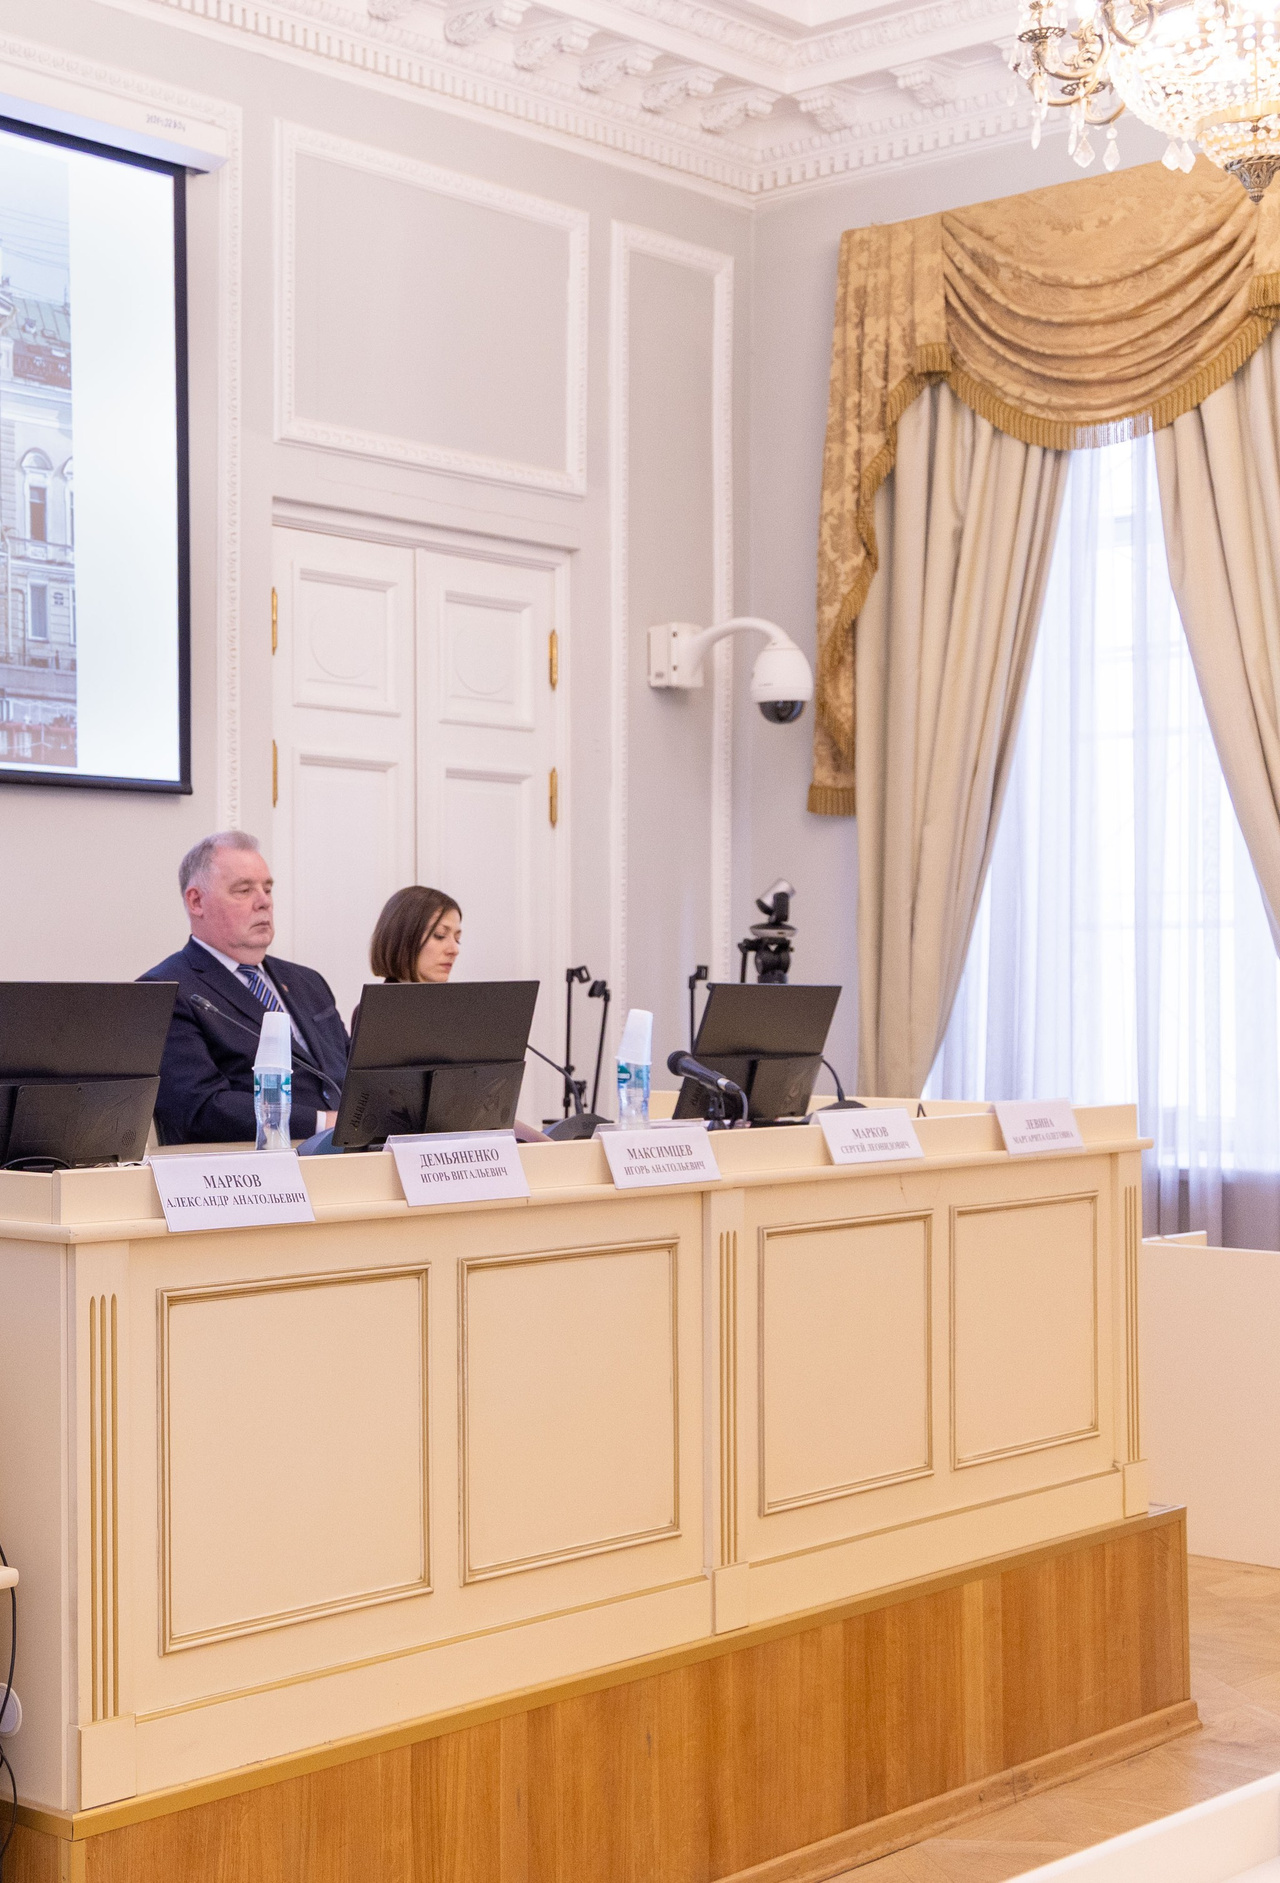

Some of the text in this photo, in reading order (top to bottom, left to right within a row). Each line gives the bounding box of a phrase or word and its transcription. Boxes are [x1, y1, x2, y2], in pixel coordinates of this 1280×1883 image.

[1025, 1118, 1055, 1130] ЛЕВИНА
[851, 1126, 889, 1139] МАРКОВ
[626, 1144, 693, 1160] МАКСИМЦЕВ
[840, 1140, 911, 1155] СЕРГЕЙ ЛЕОНИДОВИЧ
[419, 1148, 500, 1169] ДЕМЬЯНЕНКО
[420, 1166, 509, 1184] ИГОРЬ ВИТАЛЬЕВИЧ
[623, 1160, 707, 1176] ИГОРЬ АНАТОЛЬЕВИЧ
[202, 1174, 262, 1189] МАРКОВ
[166, 1192, 307, 1208] АЛЕКСАНДР АНАТОЛЬЕВИЧ
